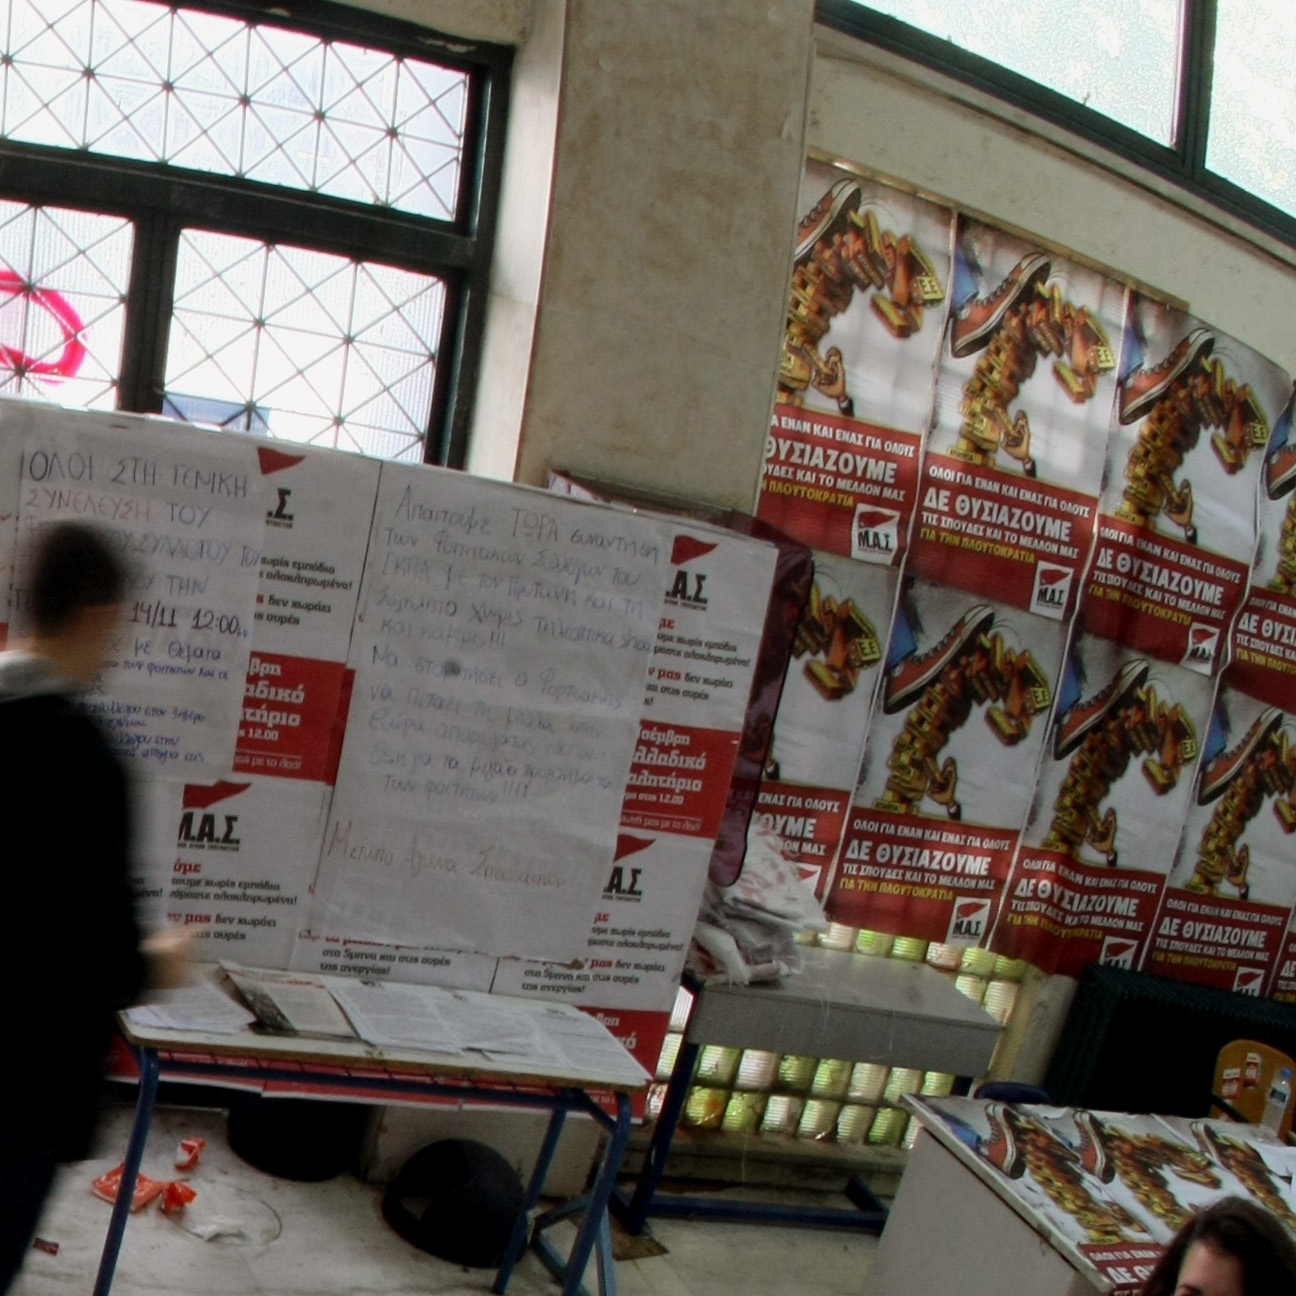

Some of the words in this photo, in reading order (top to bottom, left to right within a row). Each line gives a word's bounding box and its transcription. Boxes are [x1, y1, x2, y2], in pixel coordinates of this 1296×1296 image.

[781, 416, 810, 433] ΕΝΑΝ
[813, 423, 833, 438] ΚΑΙ
[836, 429, 864, 446] ΕΝΑΣ
[865, 435, 882, 451] ΓΙΑ
[884, 441, 916, 458] ΟΛΟΥΣ
[29, 450, 93, 482] ΟΛΟΙ
[111, 456, 156, 486] ΣΤΗ
[173, 464, 248, 498] ΓΕΝΙΚΗ
[796, 469, 816, 483] ΚΑΙ
[818, 474, 834, 487] ΤΟ
[836, 478, 882, 497] ΜΕΛΛΟΝ
[882, 487, 905, 501] ΜΑΣ
[929, 466, 955, 481] ΟΛΟΙ
[957, 472, 973, 486] ΓΙΑ
[975, 478, 1000, 494] ΕΝΑΝ
[1002, 485, 1017, 498] ΚΑΙ
[1019, 488, 1043, 506] ΕΝΑΣ
[1044, 495, 1058, 509] ΓΙΑ
[1060, 500, 1090, 518] ΟΛΟΥΣ
[169, 503, 212, 528] ΤΟΥ
[923, 487, 951, 512] ΔΕ
[955, 494, 1072, 542] ΘΥΣΙΑΖΟΥΜΕ
[922, 512, 938, 526] ΤΙΣ
[940, 517, 985, 537] ΣΠΟΥΔΕΣ
[986, 527, 1002, 540] ΚΑΙ
[1004, 531, 1018, 544] ΤΟ
[1019, 535, 1059, 555] ΜΕΛΛΟΝ
[1059, 545, 1079, 559] ΜΑΣ
[1096, 547, 1114, 569] ΔΕ
[1116, 552, 1224, 606] ΘΥΣΙΑΖΟΥΜΕ
[129, 600, 177, 629] 14/11
[1238, 612, 1260, 634] ΔΕ
[640, 727, 690, 746] οέμβρη
[633, 745, 706, 770] λλαδικό
[628, 769, 702, 793] αλητήριο
[801, 842, 825, 856] ΜΑΣ
[853, 819, 879, 832] ΟΛΟΙ
[880, 822, 895, 835] ΓΙΑ
[897, 825, 923, 839] ΕΝΑΝ
[924, 830, 940, 842] ΚΑΙ
[942, 832, 965, 845] ΕΝΑΣ
[966, 836, 981, 848] ΓΙΑ
[982, 837, 1011, 851] ΟΛΟΥΣ
[845, 839, 873, 862] ΔΕ
[876, 846, 992, 876] ΘΥΣΙΑΖΟΥΜΕ
[1014, 878, 1037, 897] ΔΕ
[1037, 879, 1139, 917] ΘΥΣΙΑΖΟΥΜΕ
[1158, 917, 1181, 936] ΔΕ
[1182, 920, 1267, 948] ΘΥΣΙΑΖΟΥΜΕ
